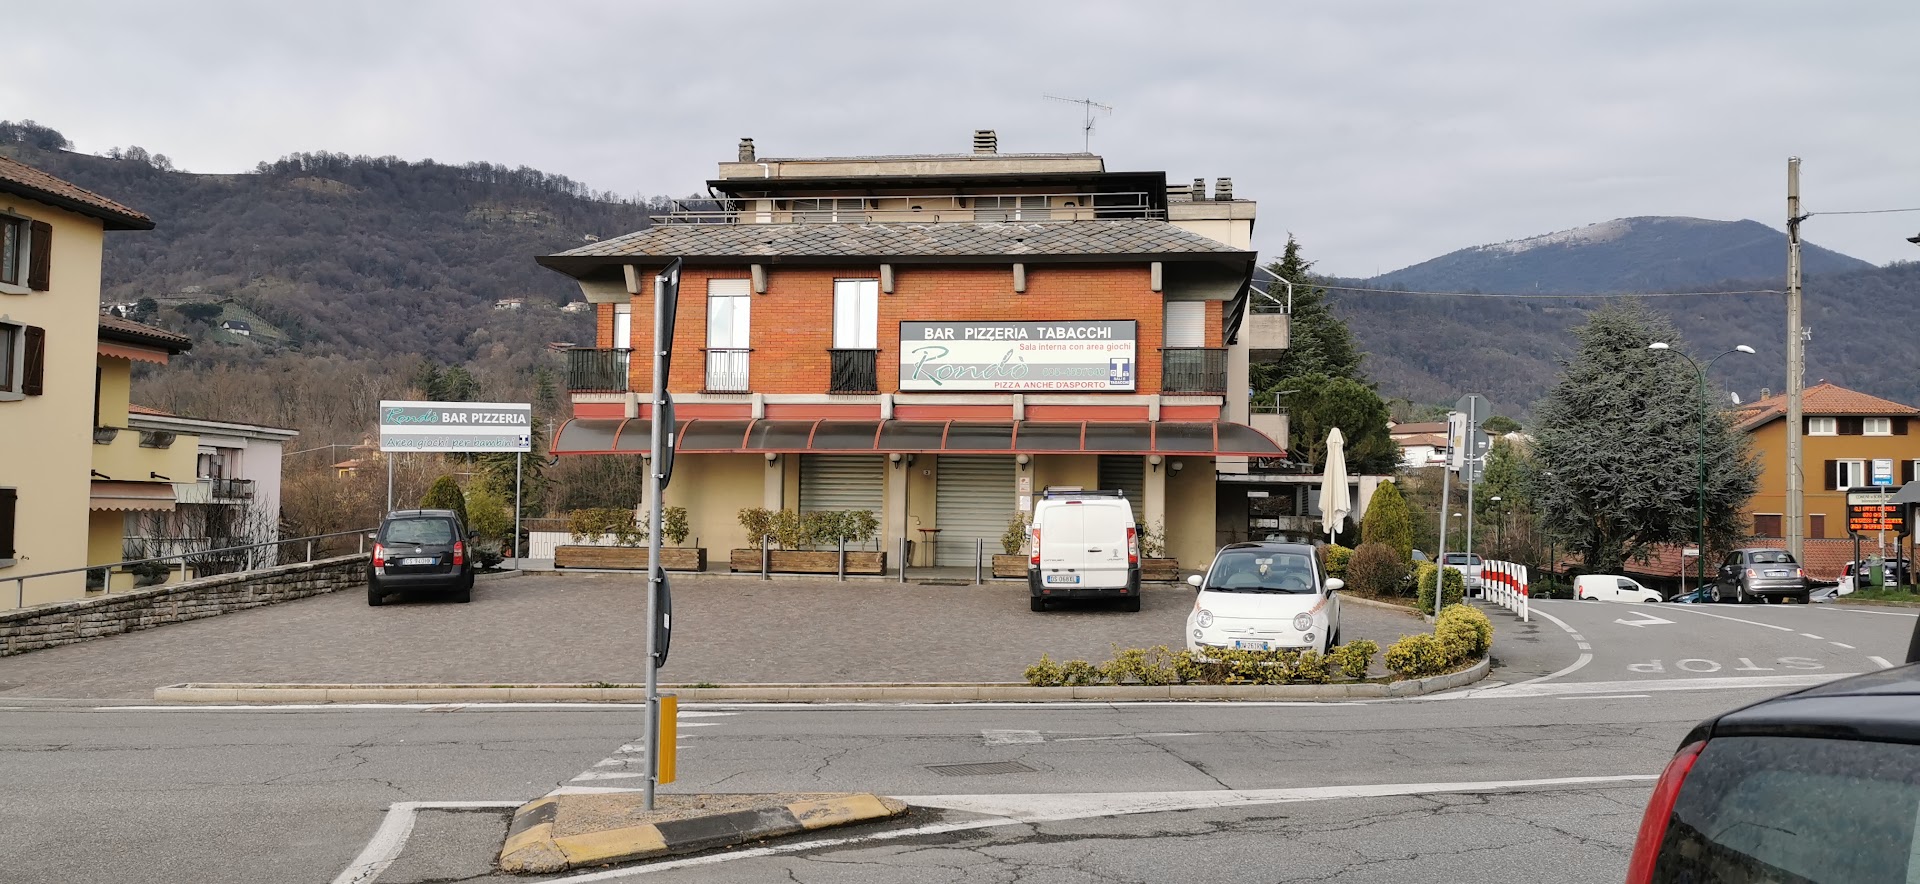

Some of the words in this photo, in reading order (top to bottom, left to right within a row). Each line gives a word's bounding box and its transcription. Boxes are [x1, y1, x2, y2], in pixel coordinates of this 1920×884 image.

[924, 327, 955, 340] BAR
[964, 327, 1029, 340] PIZZERIA
[1036, 326, 1112, 339] TABACCHI
[1019, 343, 1038, 351] Sala
[1039, 343, 1067, 351] interna
[1106, 342, 1132, 352] giochi
[911, 345, 1029, 386] Rondò
[994, 381, 1021, 389] PIZZA
[1023, 381, 1054, 389] ANCHE
[1056, 381, 1106, 389] D'ASPORTO
[442, 412, 468, 423] BAR
[471, 413, 527, 424] PIZZERIA
[386, 437, 413, 447] Area
[416, 437, 449, 449] giochi
[451, 441, 470, 449] per
[473, 437, 515, 447] bambini
[1626, 656, 1825, 674] STOP
